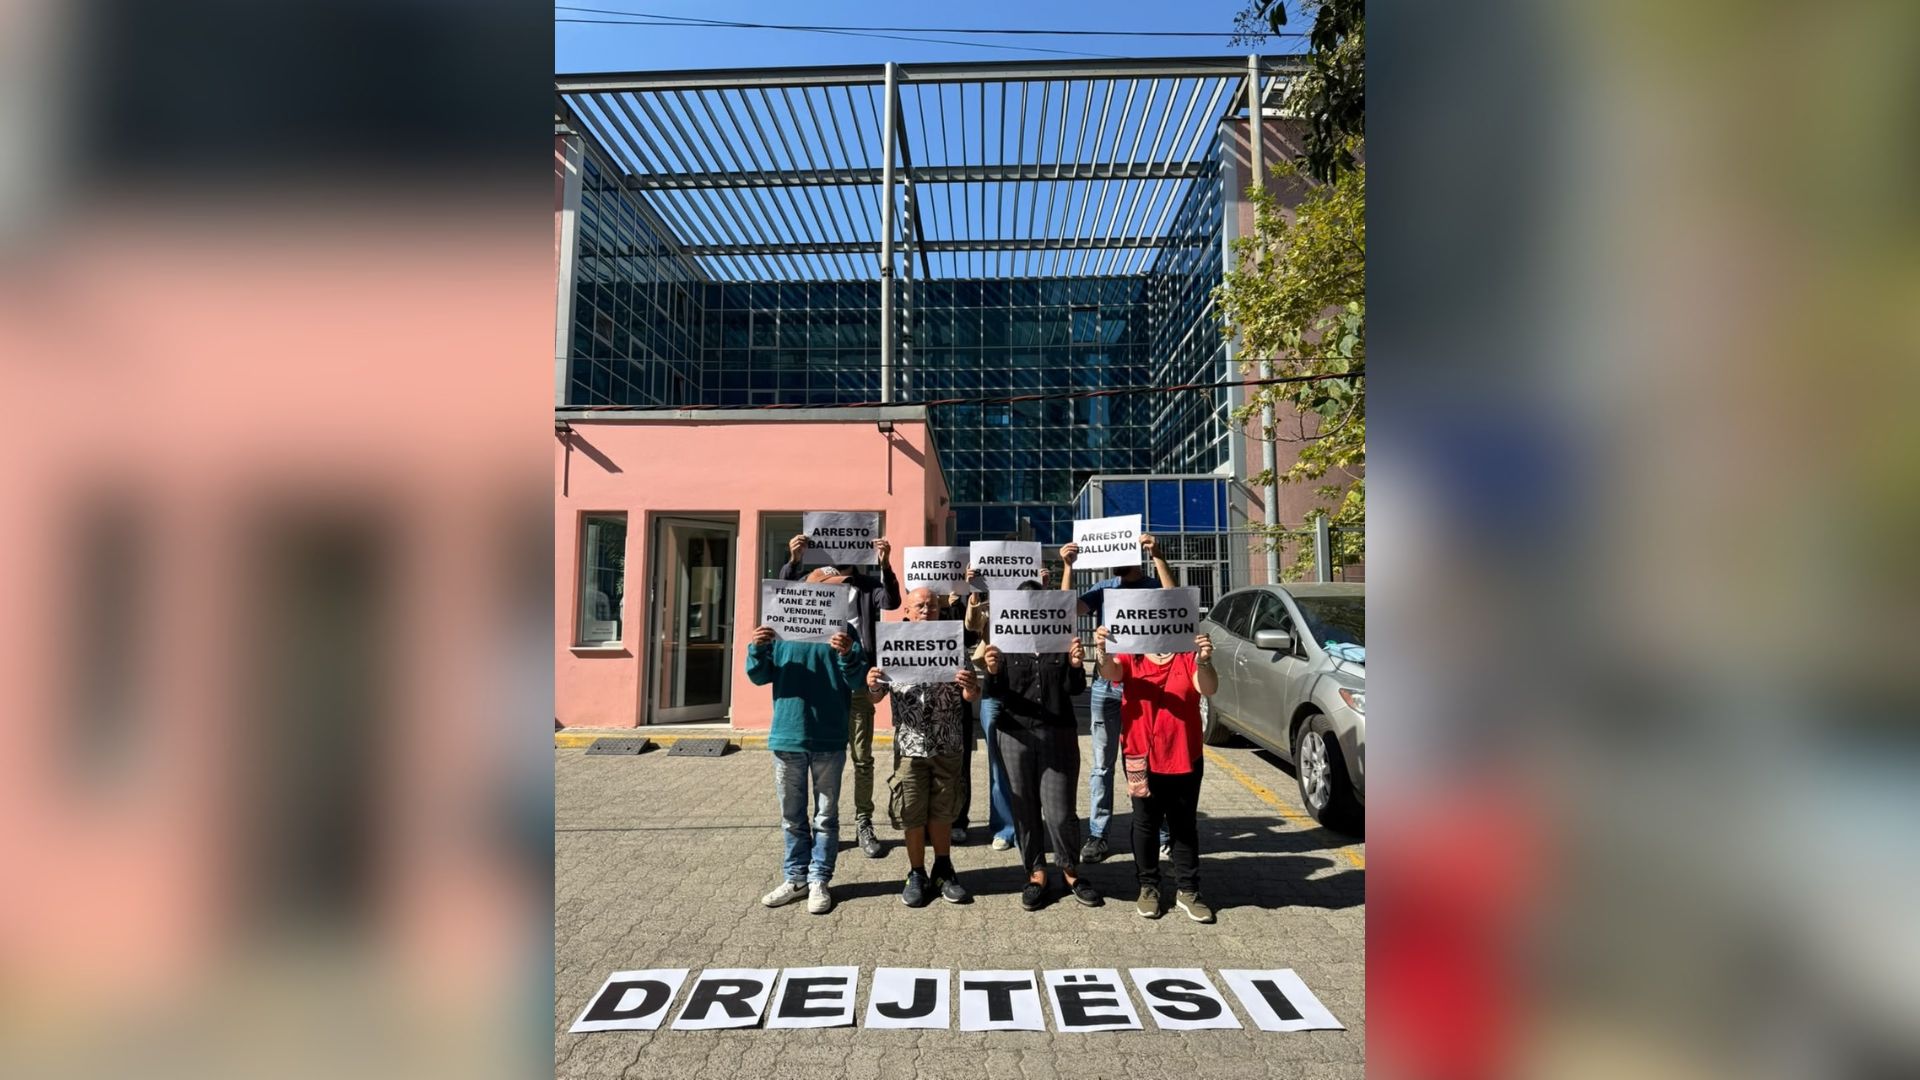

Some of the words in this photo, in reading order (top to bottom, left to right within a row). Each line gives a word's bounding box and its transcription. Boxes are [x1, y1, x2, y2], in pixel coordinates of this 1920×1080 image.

[812, 528, 870, 537] ARRESTO
[1081, 530, 1132, 542] ARRESTO
[808, 540, 874, 550] BALLUKUN
[1078, 542, 1137, 554] BALLUKUN
[911, 561, 962, 569] ARRESTO
[978, 556, 1034, 565] ARRESTO
[907, 573, 966, 581] BALLUKUN
[975, 568, 1039, 577] BALLUKUN
[815, 590, 836, 598] NUK
[783, 607, 826, 617] VENDIME,
[1000, 609, 1067, 620] ARRESTO
[1115, 608, 1188, 620] ARRESTO
[766, 615, 785, 623] POR
[786, 616, 827, 626] JETOJNË
[784, 625, 825, 635] PASOJAT.
[995, 624, 1072, 635] BALLUKUN
[1111, 623, 1194, 635] BALLUKUN
[882, 639, 958, 651] ARRESTO
[882, 656, 959, 667] BALLUKUN
[582, 975, 1304, 1027] DREJTËSI
